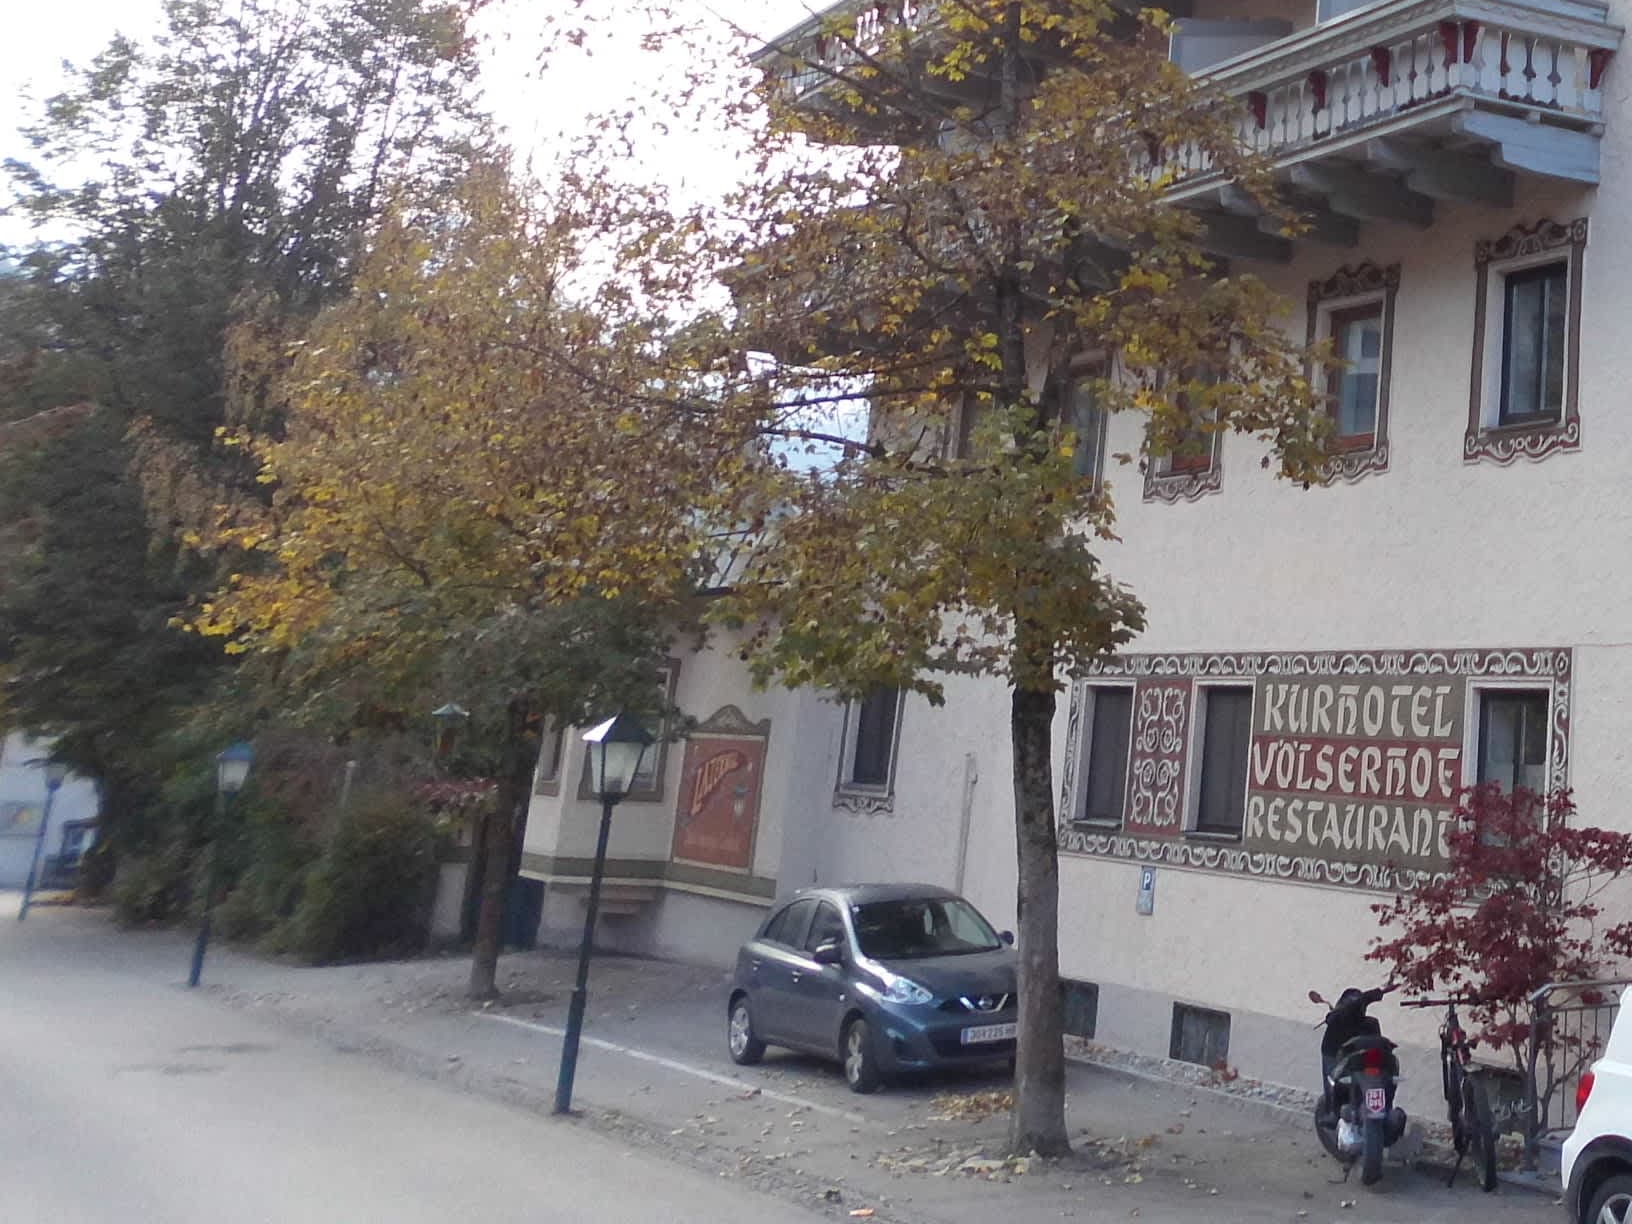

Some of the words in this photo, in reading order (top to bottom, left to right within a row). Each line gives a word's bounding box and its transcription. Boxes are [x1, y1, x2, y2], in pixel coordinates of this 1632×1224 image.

[1263, 683, 1455, 737] KURHOTEL
[1252, 738, 1461, 798] VÖLSERHOF
[1247, 795, 1458, 858] RESTAURANT
[1143, 871, 1152, 890] P
